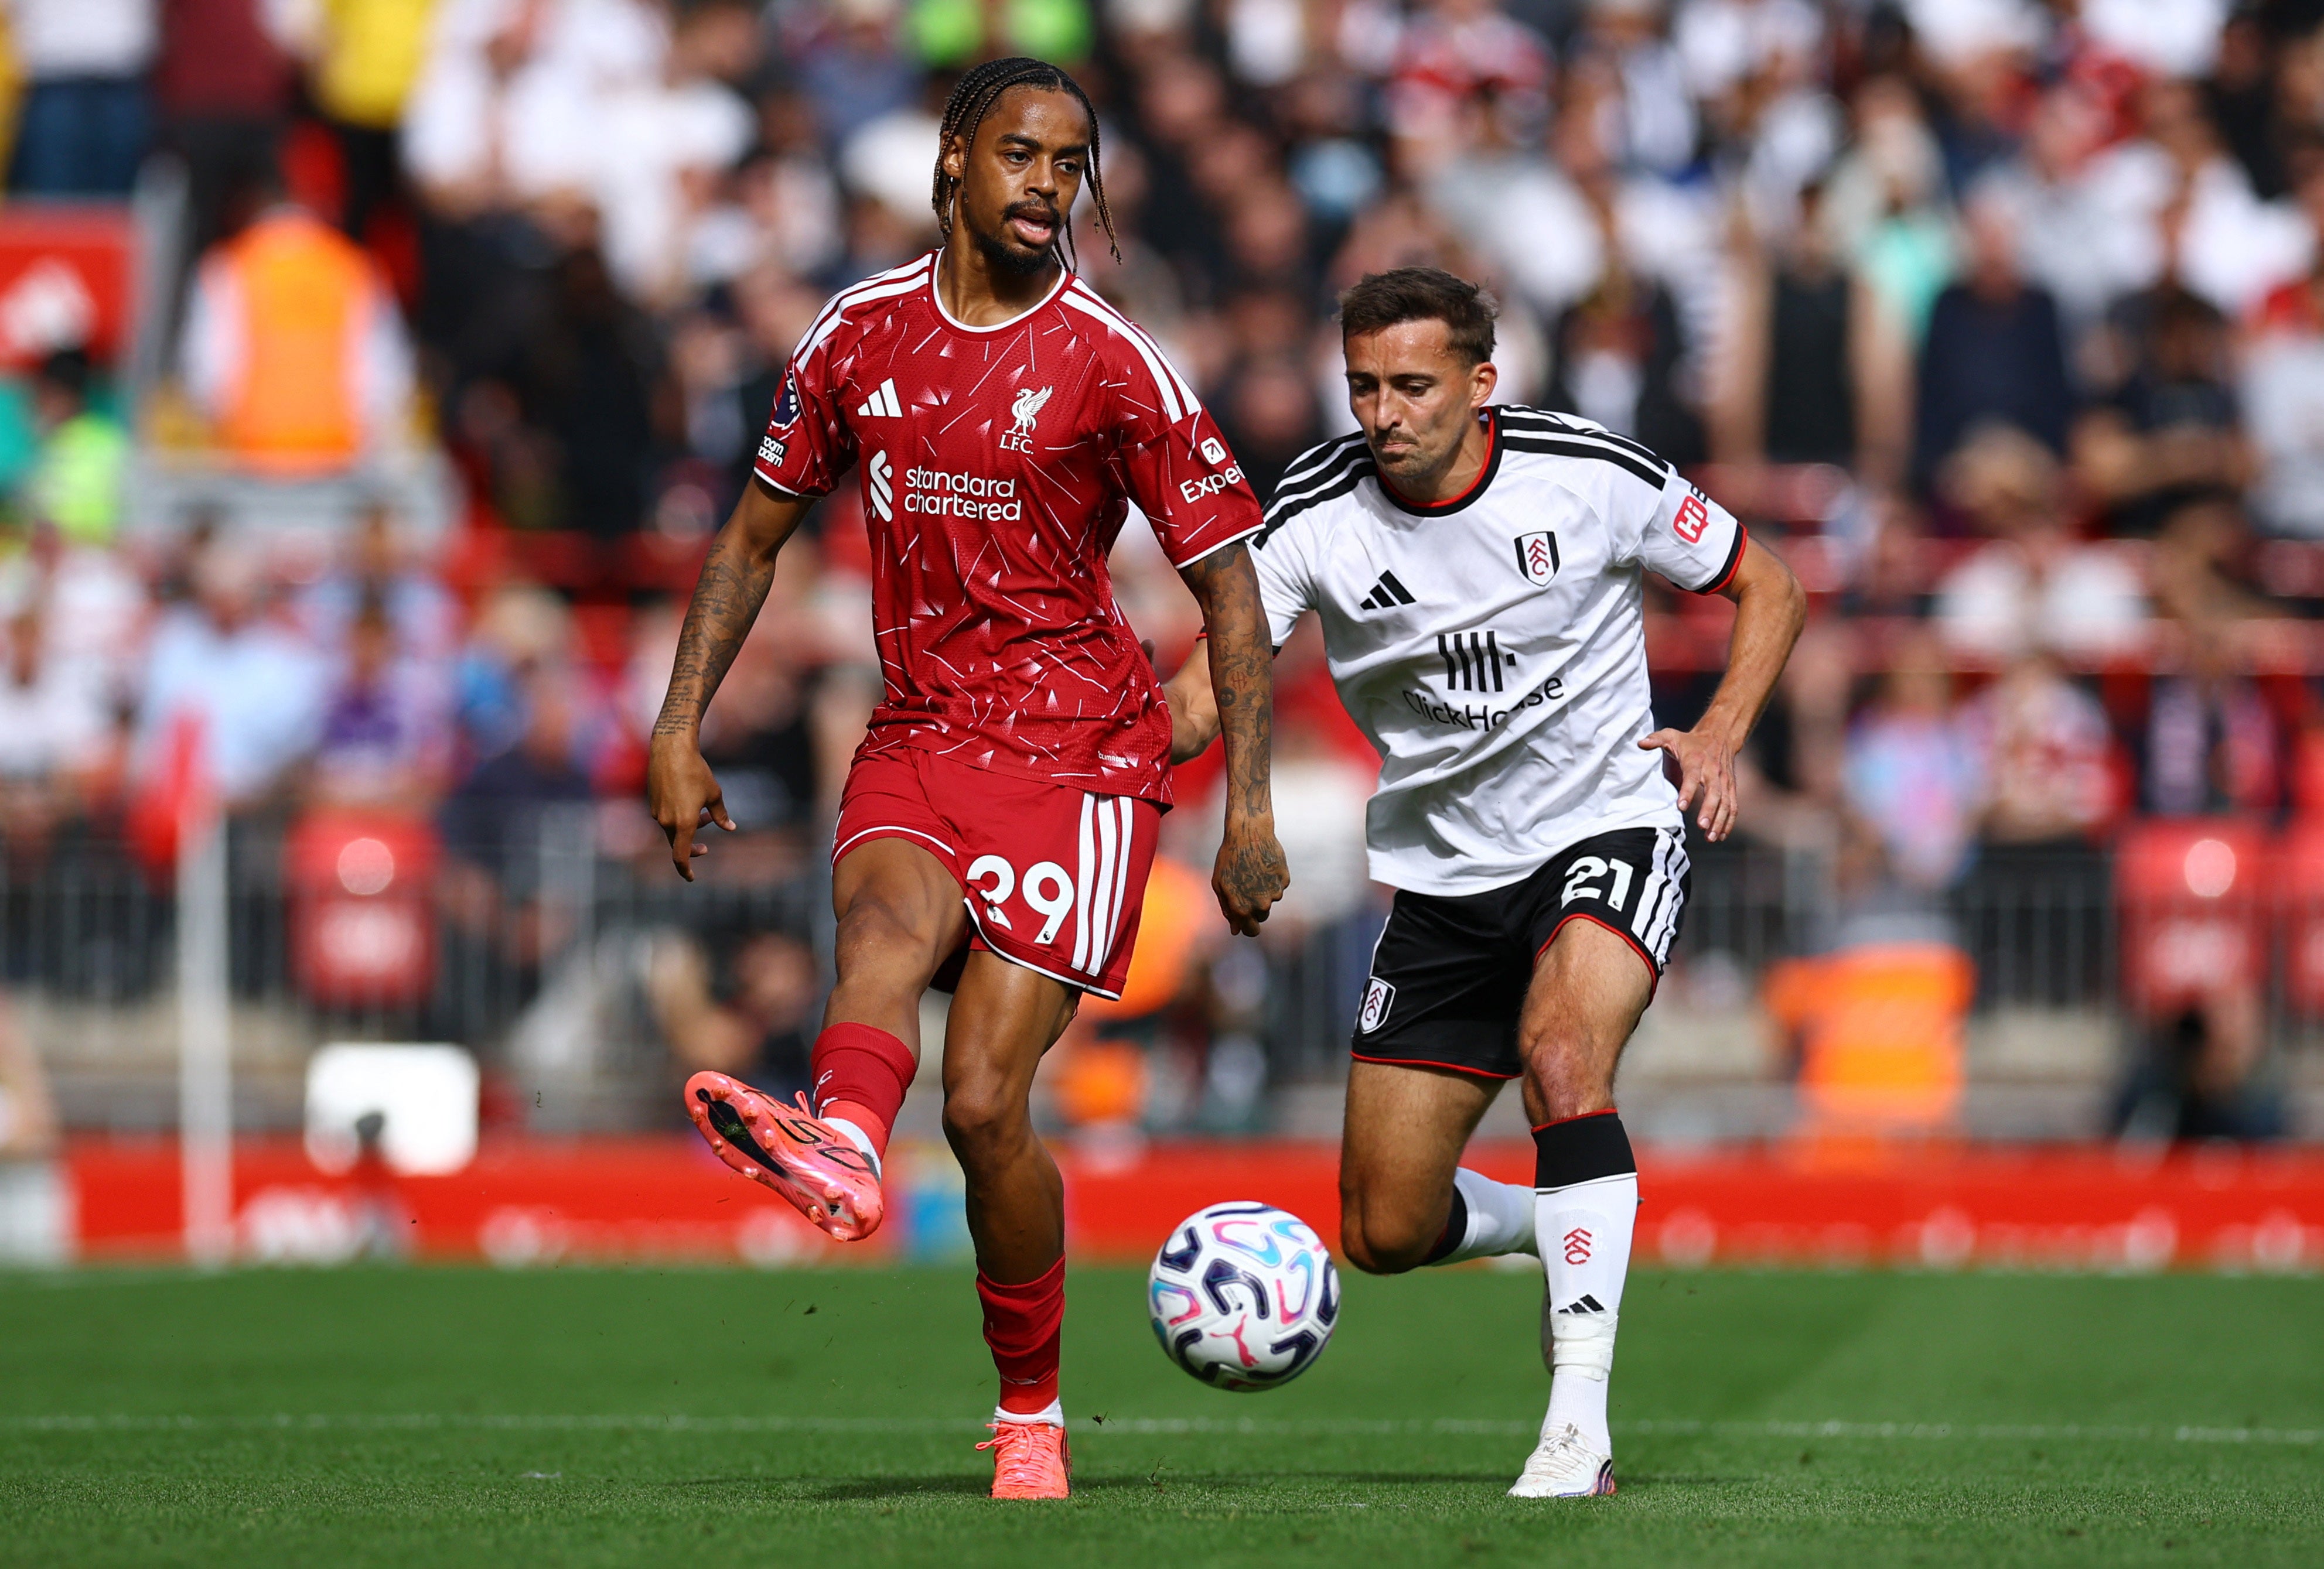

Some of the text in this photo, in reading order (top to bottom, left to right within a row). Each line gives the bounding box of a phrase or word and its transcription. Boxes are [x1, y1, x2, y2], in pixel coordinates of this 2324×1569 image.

[905, 465, 1015, 498] standard
[1179, 460, 1245, 504] Expe
[905, 490, 1022, 521] chartered
[1402, 676, 1564, 732] ClickHose
[1561, 855, 1634, 912] 21
